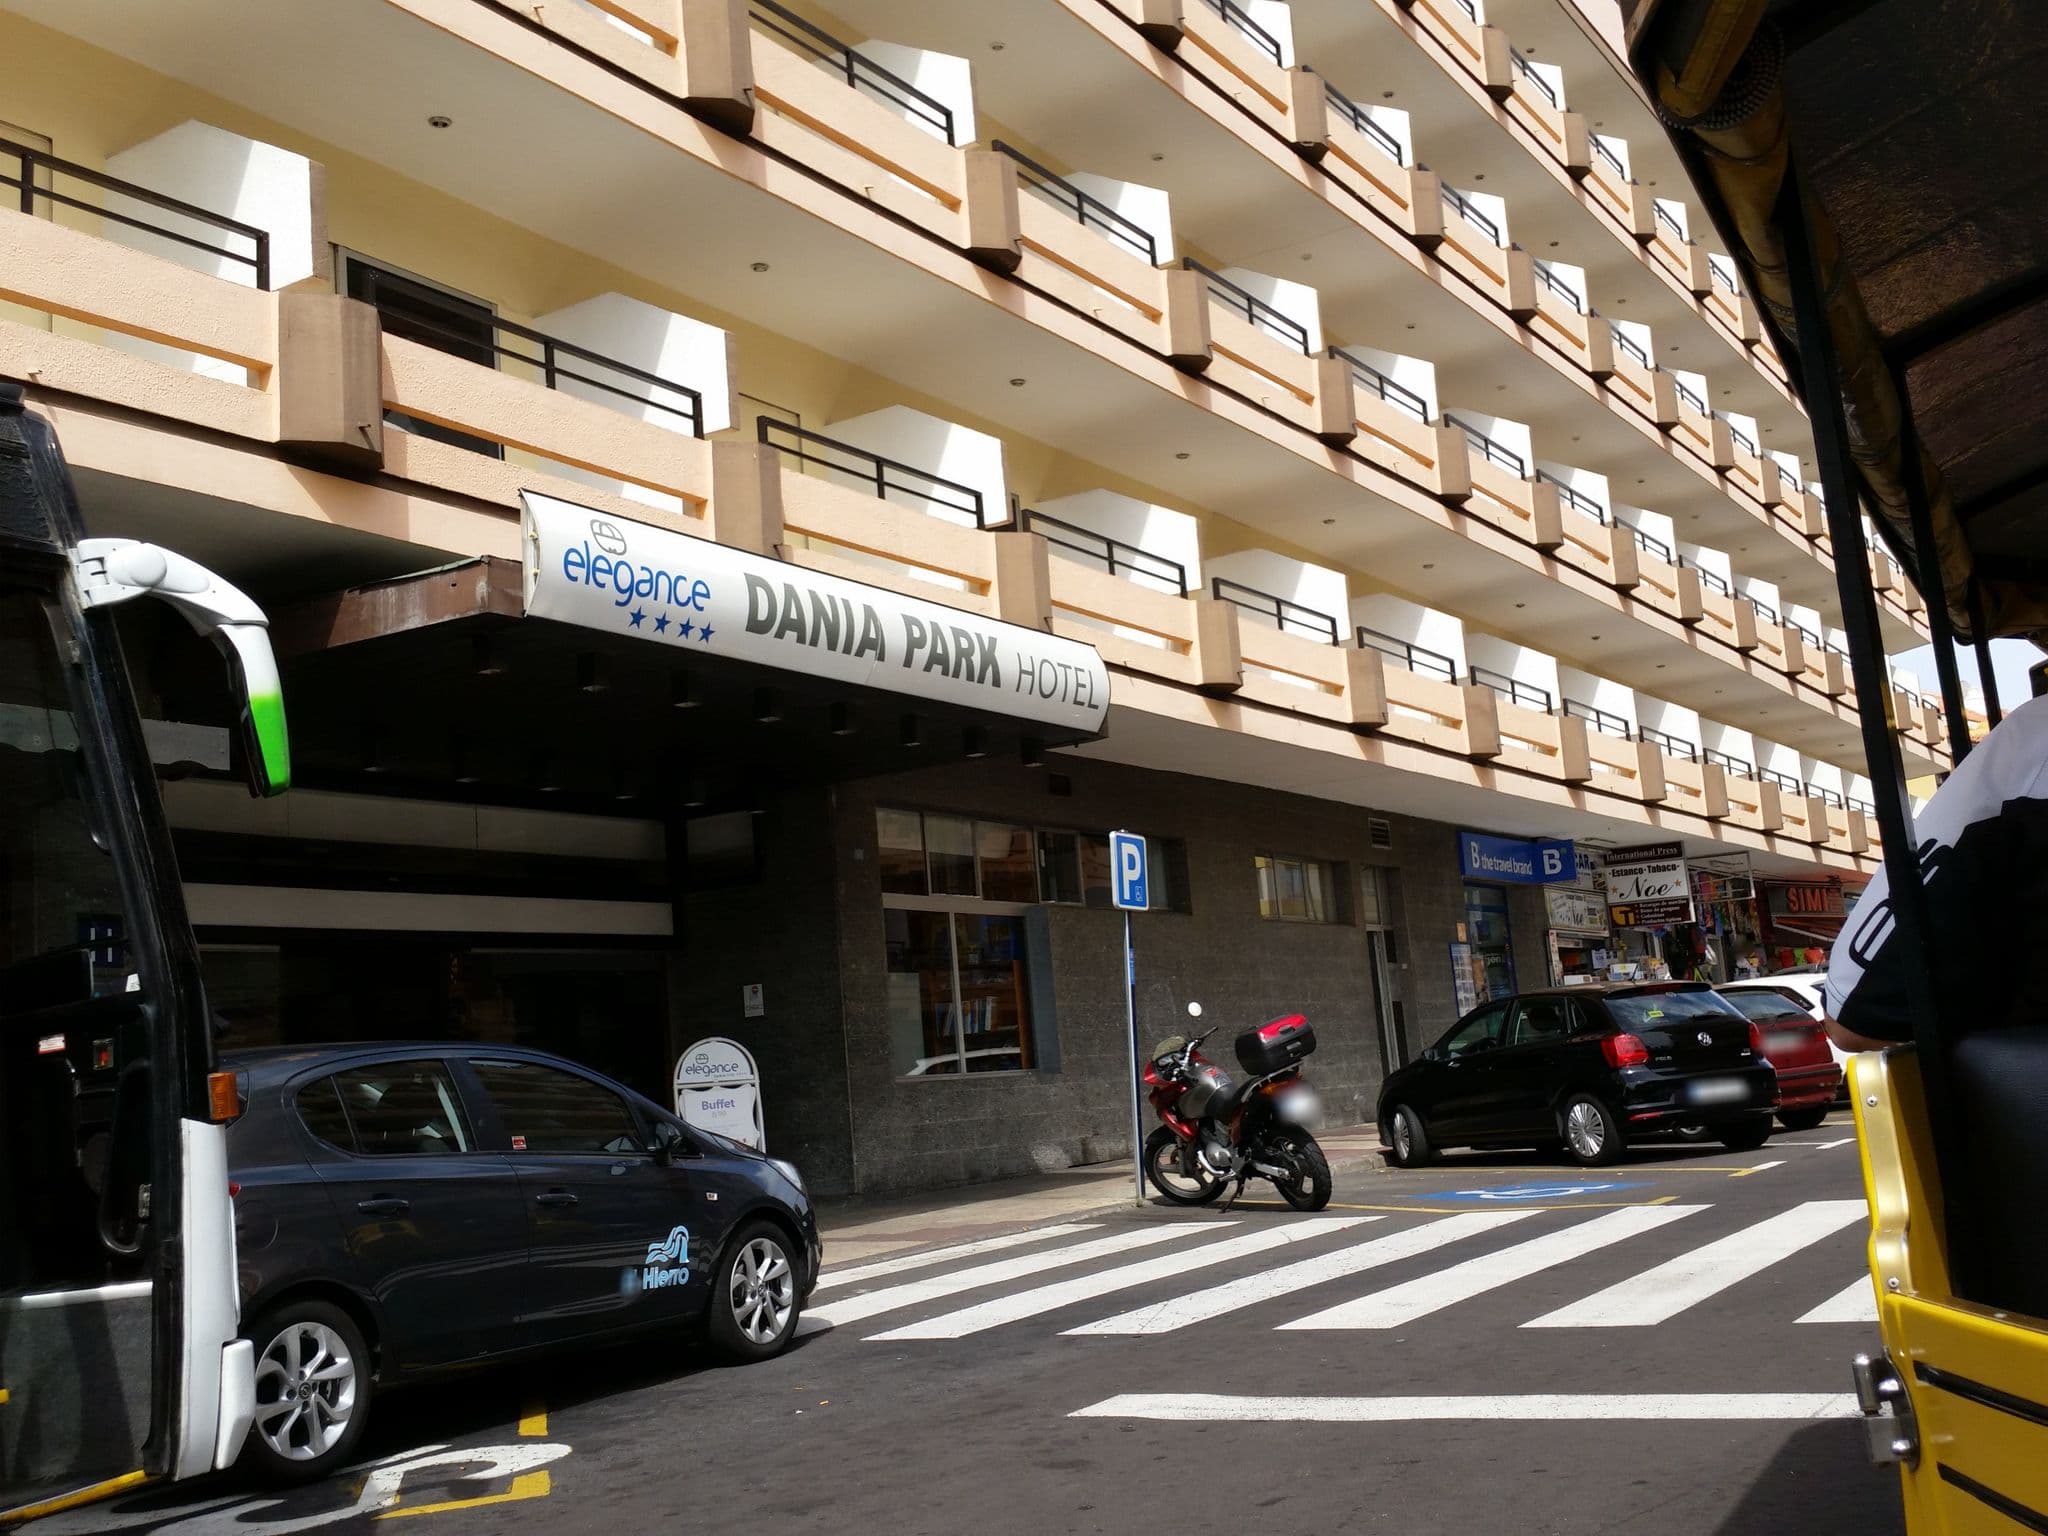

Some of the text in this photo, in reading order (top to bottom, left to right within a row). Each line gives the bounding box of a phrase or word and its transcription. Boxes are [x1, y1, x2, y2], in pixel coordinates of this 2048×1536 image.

[563, 540, 711, 611] elegance
[744, 572, 1099, 710] DANIA PARK HOTEL
[1470, 841, 1533, 875] B the travel brand
[1543, 848, 1562, 875] B
[1606, 847, 1678, 860] International Press
[1121, 842, 1141, 900] P
[685, 1062, 739, 1078] elegance
[701, 1099, 736, 1111] Buffet
[642, 1266, 689, 1290] Hierro
